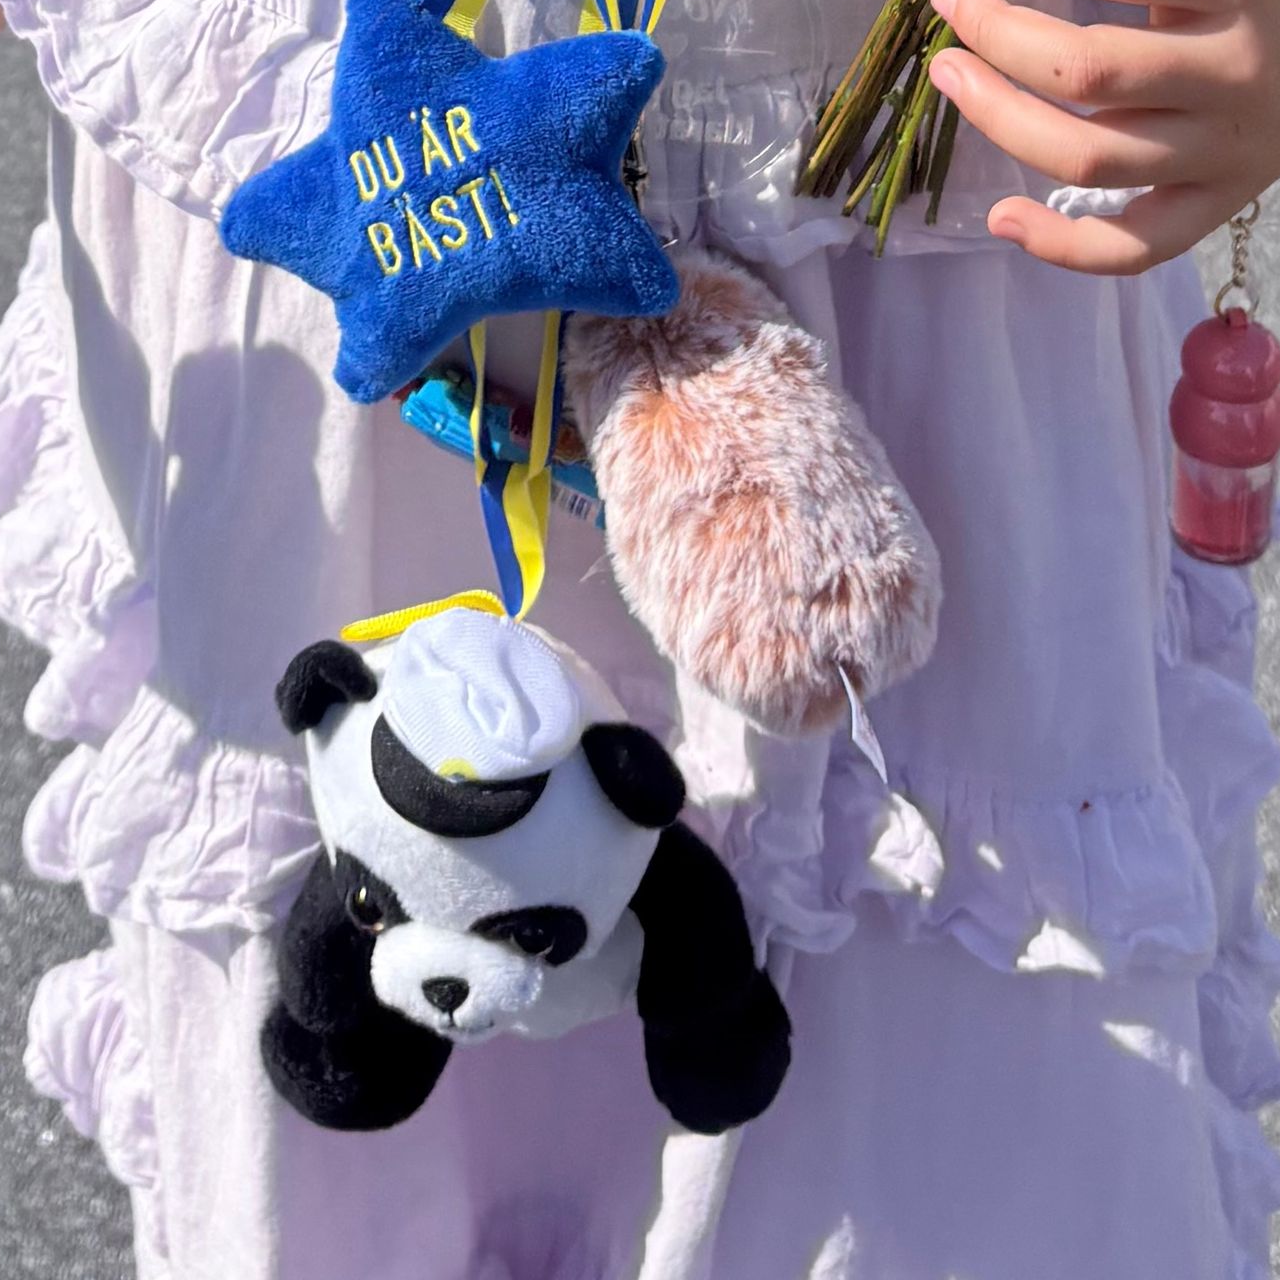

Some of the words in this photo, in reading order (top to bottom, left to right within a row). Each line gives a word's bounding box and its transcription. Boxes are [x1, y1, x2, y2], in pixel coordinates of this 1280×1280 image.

[349, 136, 405, 202] DU
[409, 106, 481, 176] ÄR
[367, 167, 520, 277] BÄST!
